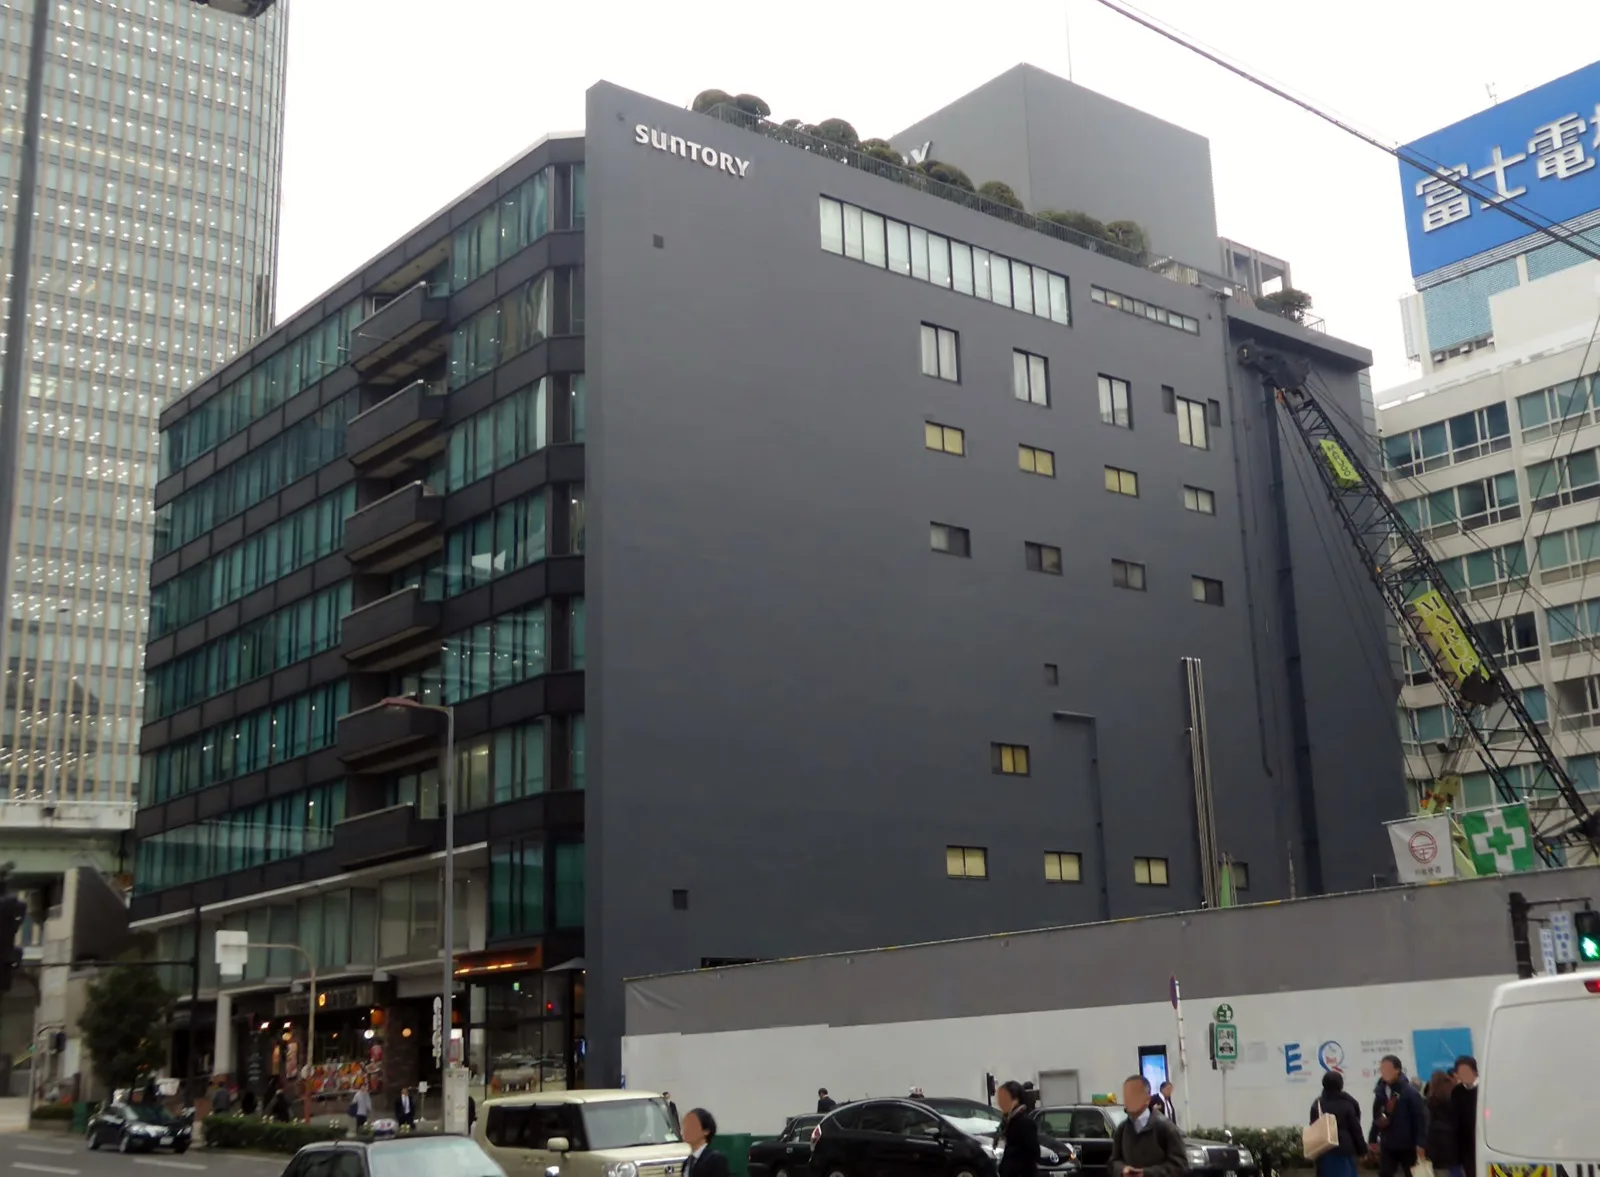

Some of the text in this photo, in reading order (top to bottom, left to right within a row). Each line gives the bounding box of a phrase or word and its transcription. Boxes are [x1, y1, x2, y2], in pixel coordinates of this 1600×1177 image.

[635, 124, 750, 177] SUNTORY
[1415, 103, 1600, 233] 富士電
[1421, 596, 1487, 685] MARUG
